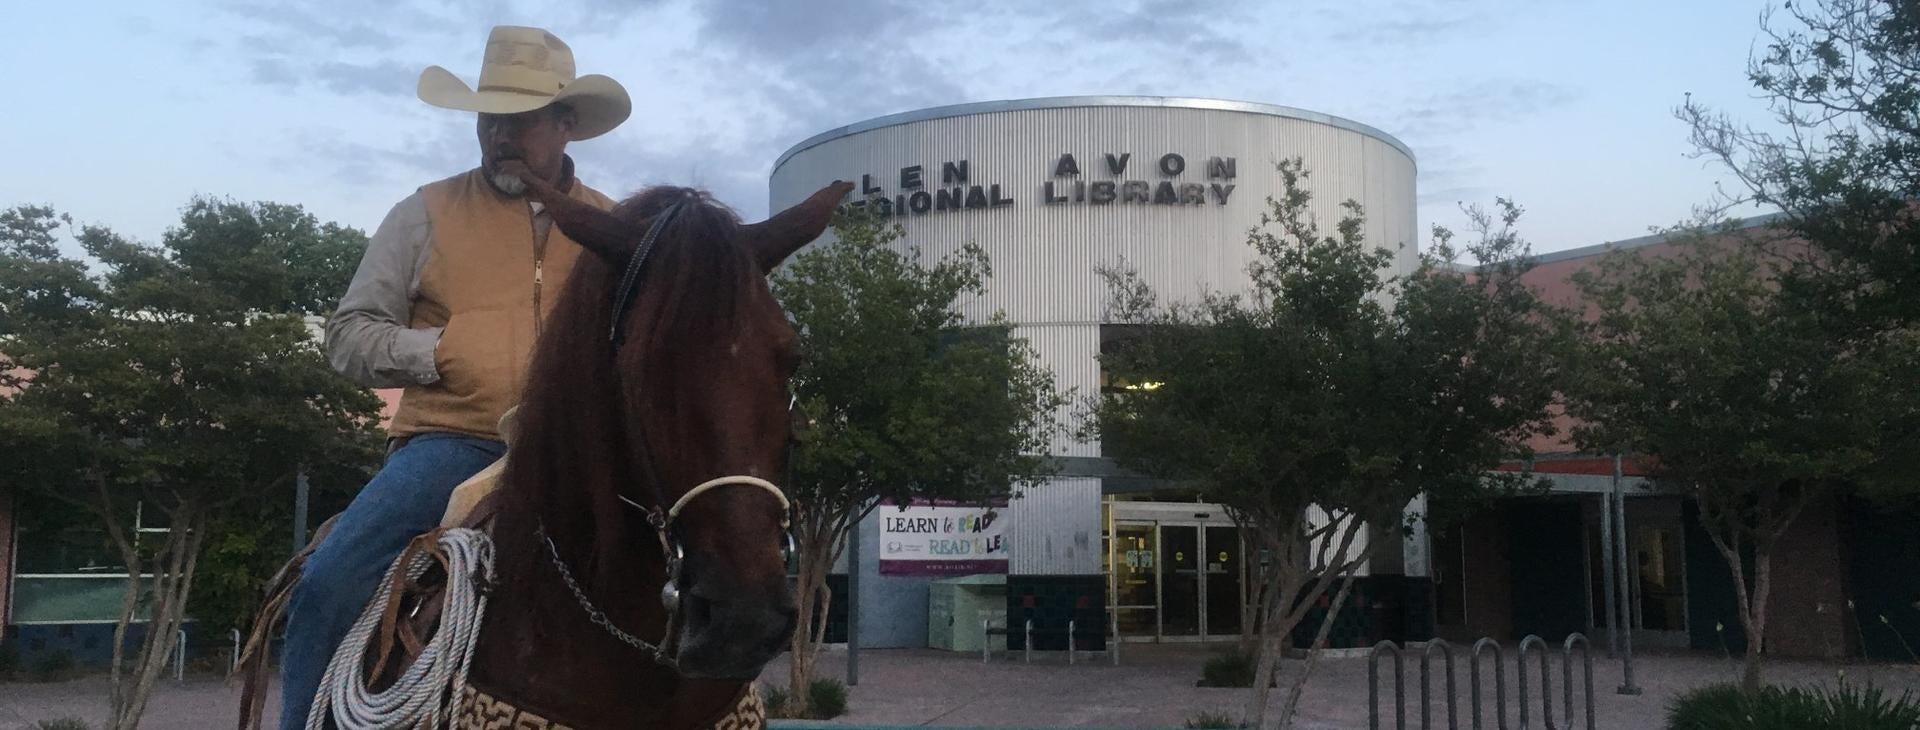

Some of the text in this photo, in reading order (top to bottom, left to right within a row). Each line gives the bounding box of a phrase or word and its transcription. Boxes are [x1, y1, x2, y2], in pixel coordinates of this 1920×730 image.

[834, 153, 1236, 195] LEN AVON
[1044, 181, 1235, 205] LIBRARY
[886, 517, 938, 533] LEARN
[943, 516, 955, 533] to
[929, 539, 970, 555] READ
